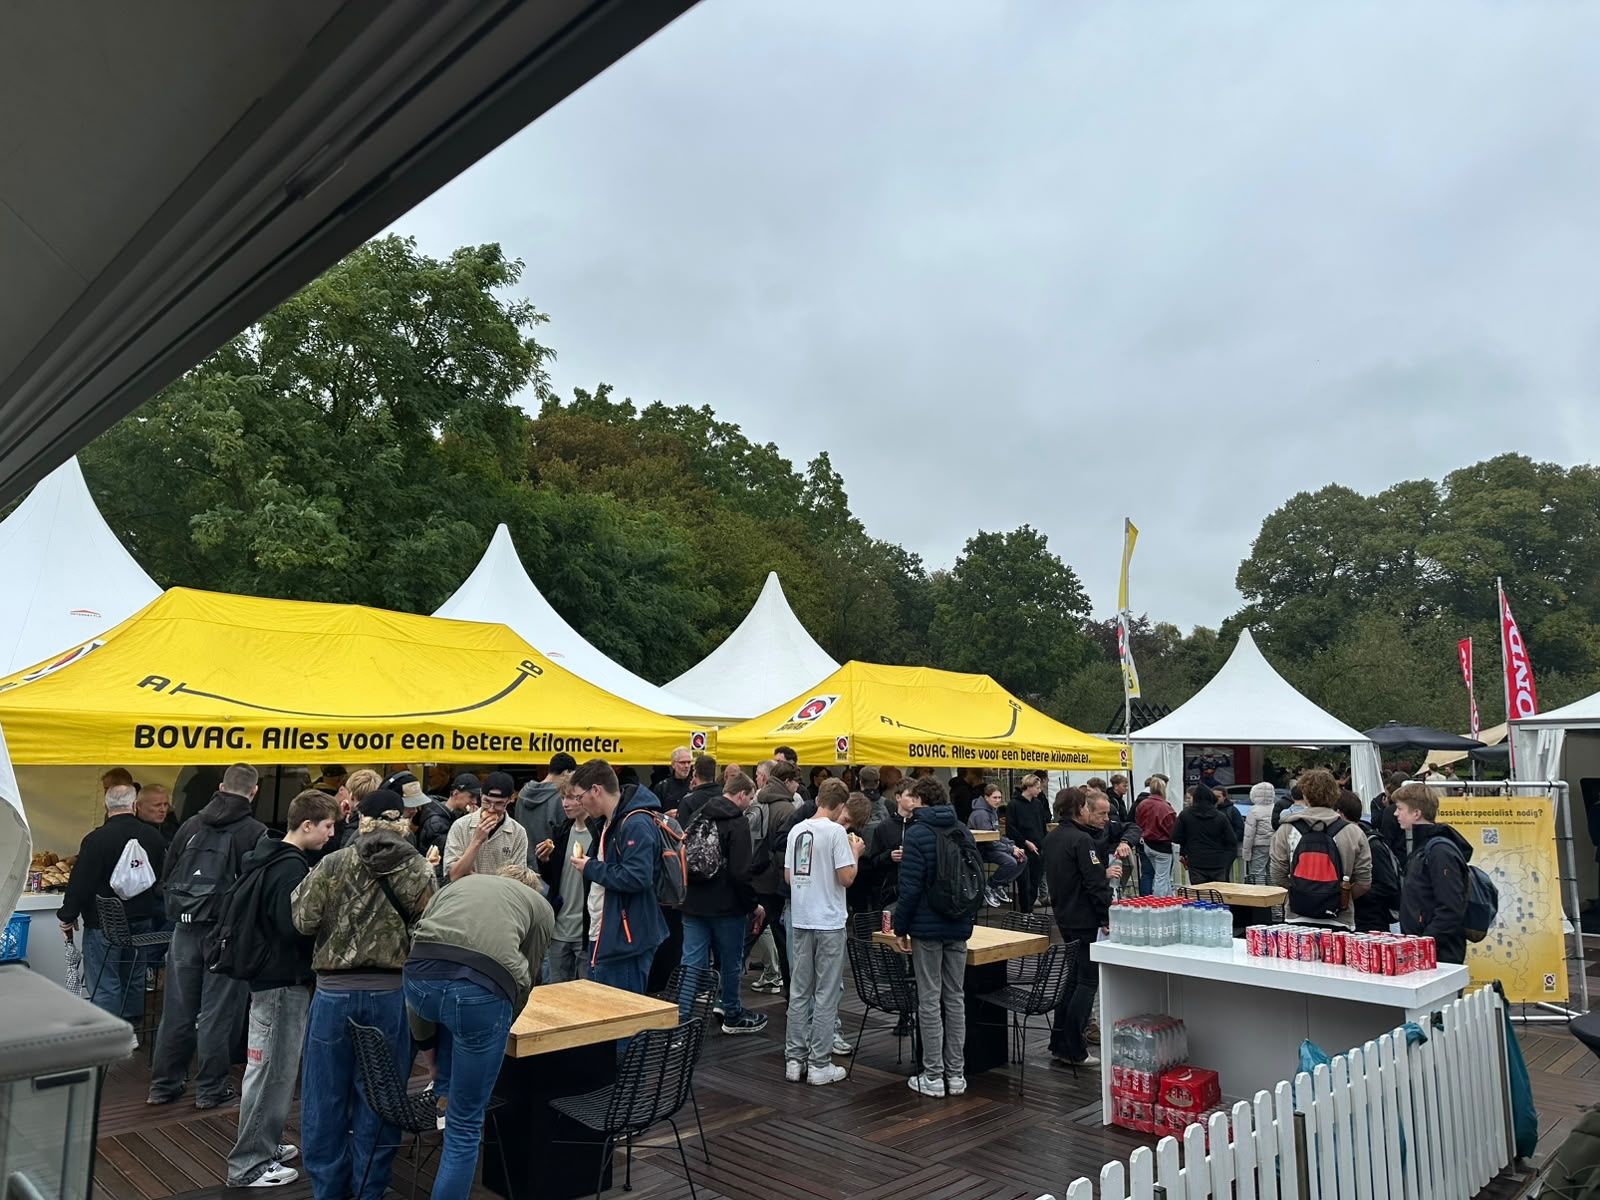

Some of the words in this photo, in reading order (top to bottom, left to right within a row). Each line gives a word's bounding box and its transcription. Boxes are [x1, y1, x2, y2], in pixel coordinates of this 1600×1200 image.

[520, 660, 544, 676] B
[136, 675, 171, 692] A
[880, 715, 893, 726] A
[134, 724, 252, 749] BOVAG.
[262, 727, 329, 750] Alles
[337, 732, 394, 750] voor
[401, 733, 445, 750] een
[452, 730, 522, 751] betere
[529, 732, 624, 753] kilometer.
[909, 743, 949, 758] BOVAG.
[952, 745, 976, 759] Alles
[978, 749, 999, 760] voor
[1001, 750, 1019, 761] een
[1020, 749, 1049, 762] betere
[1050, 750, 1091, 764] kilometer.
[1437, 808, 1513, 818] lassiekerspecialist
[1516, 808, 1544, 818] nodig?
